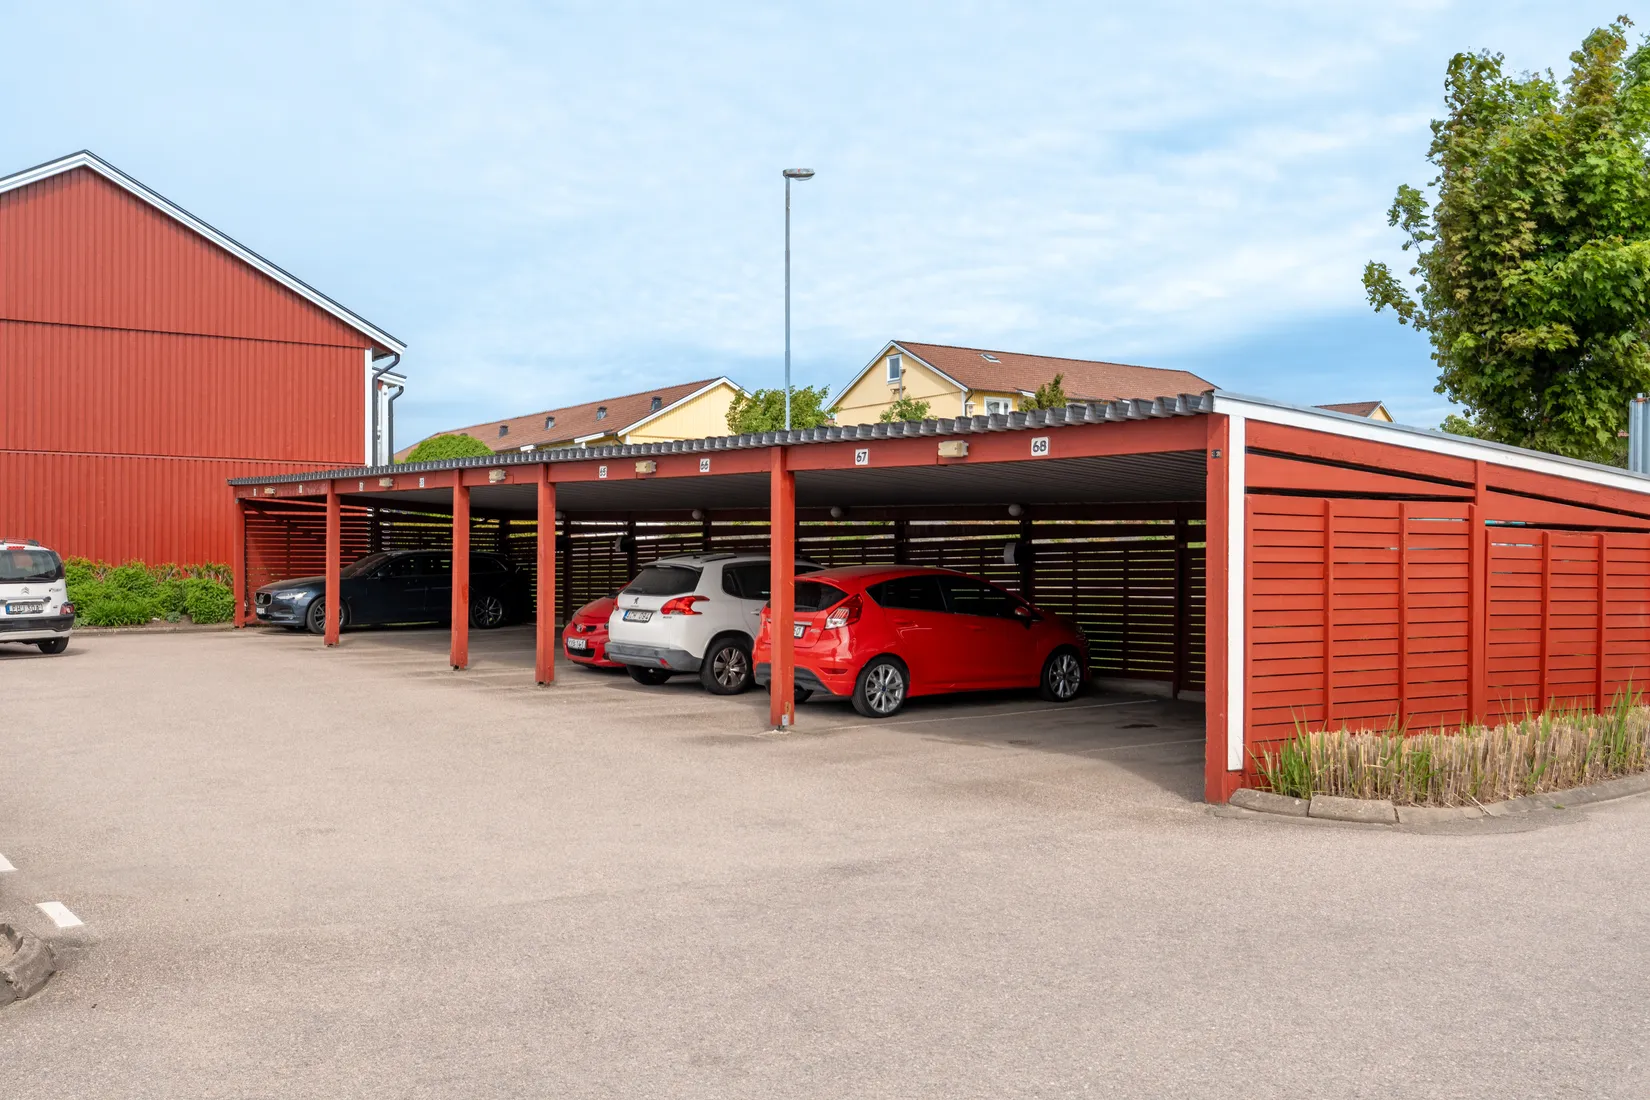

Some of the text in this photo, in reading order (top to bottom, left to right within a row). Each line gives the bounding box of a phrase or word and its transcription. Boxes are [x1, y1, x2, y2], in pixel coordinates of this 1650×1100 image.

[1032, 440, 1047, 452] 68
[856, 451, 867, 462] 67
[700, 460, 709, 470] 66
